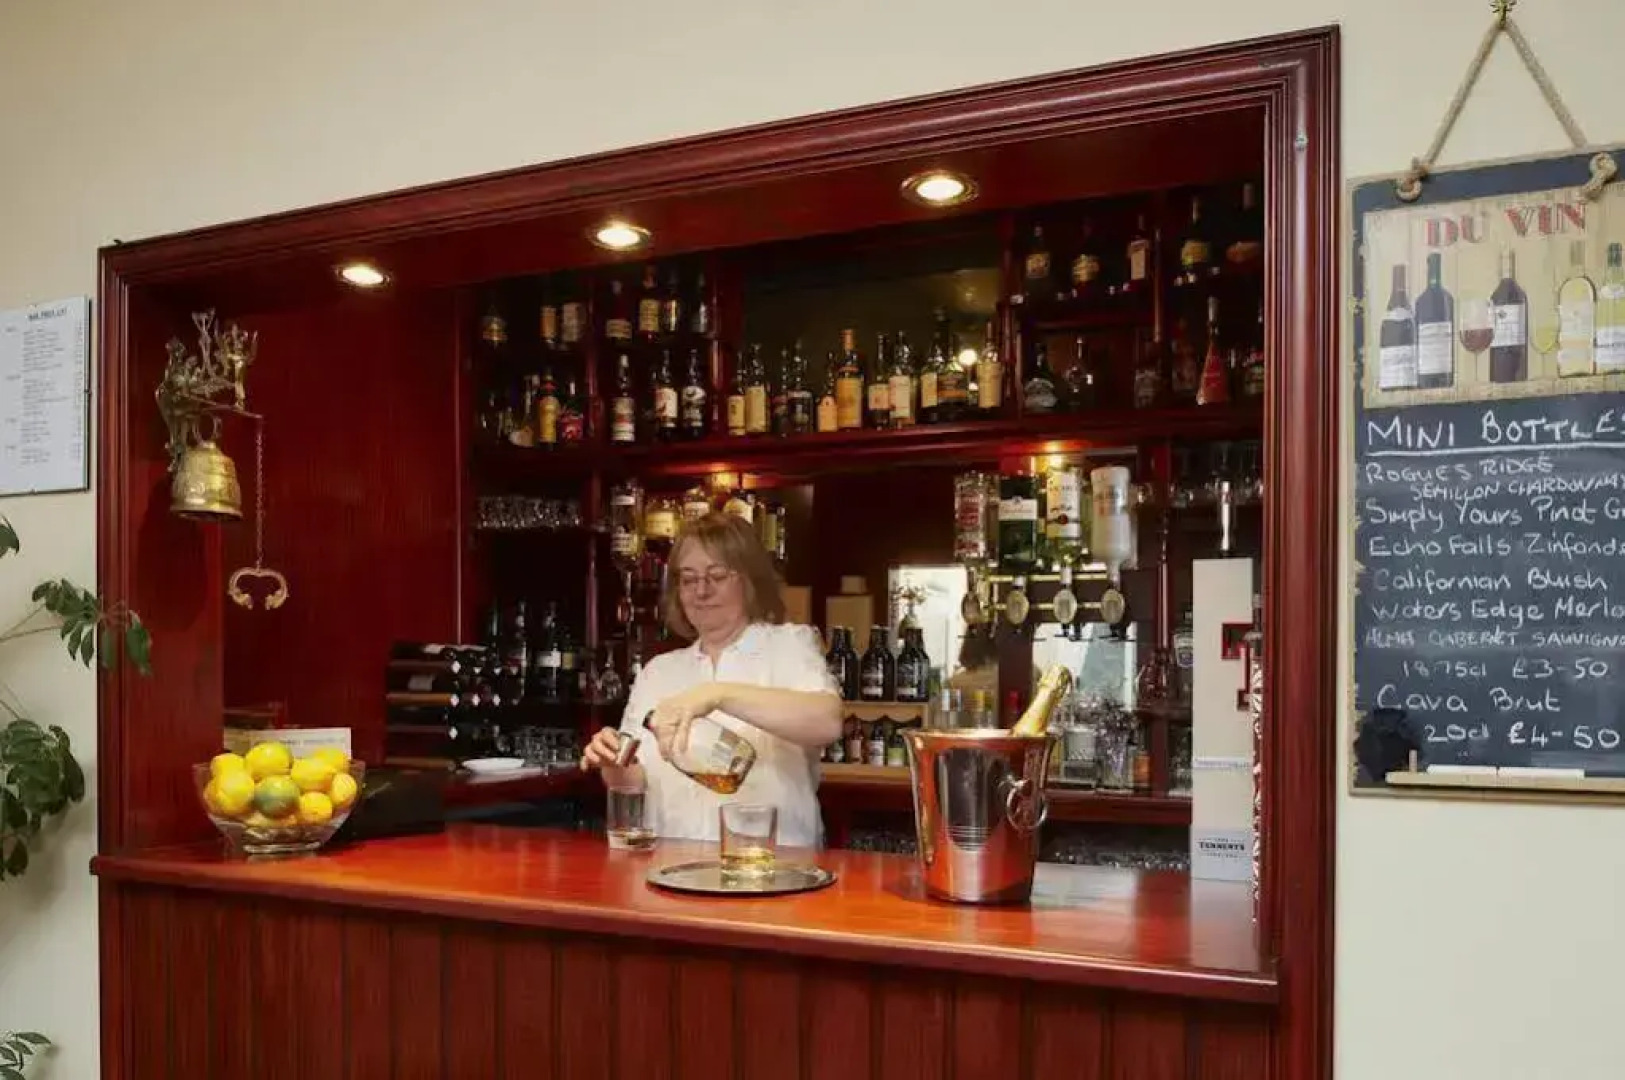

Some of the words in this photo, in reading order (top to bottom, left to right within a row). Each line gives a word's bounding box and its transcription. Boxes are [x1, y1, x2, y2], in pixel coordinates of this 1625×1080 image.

[1425, 211, 1493, 246] DU
[1505, 202, 1588, 238] VIN
[1367, 415, 1455, 449] MINI
[1365, 461, 1473, 484] ROGUES
[1479, 452, 1553, 476] RIDGE
[1409, 480, 1500, 501] SEMILLON
[1454, 498, 1522, 526] Yours
[1530, 494, 1597, 525] Pinot
[1369, 536, 1442, 557] Echo
[1449, 533, 1511, 557] Falls
[1373, 563, 1511, 595] Californian
[1471, 598, 1545, 630] Edge
[1376, 684, 1469, 712] Cava
[1489, 686, 1562, 712] Brut
